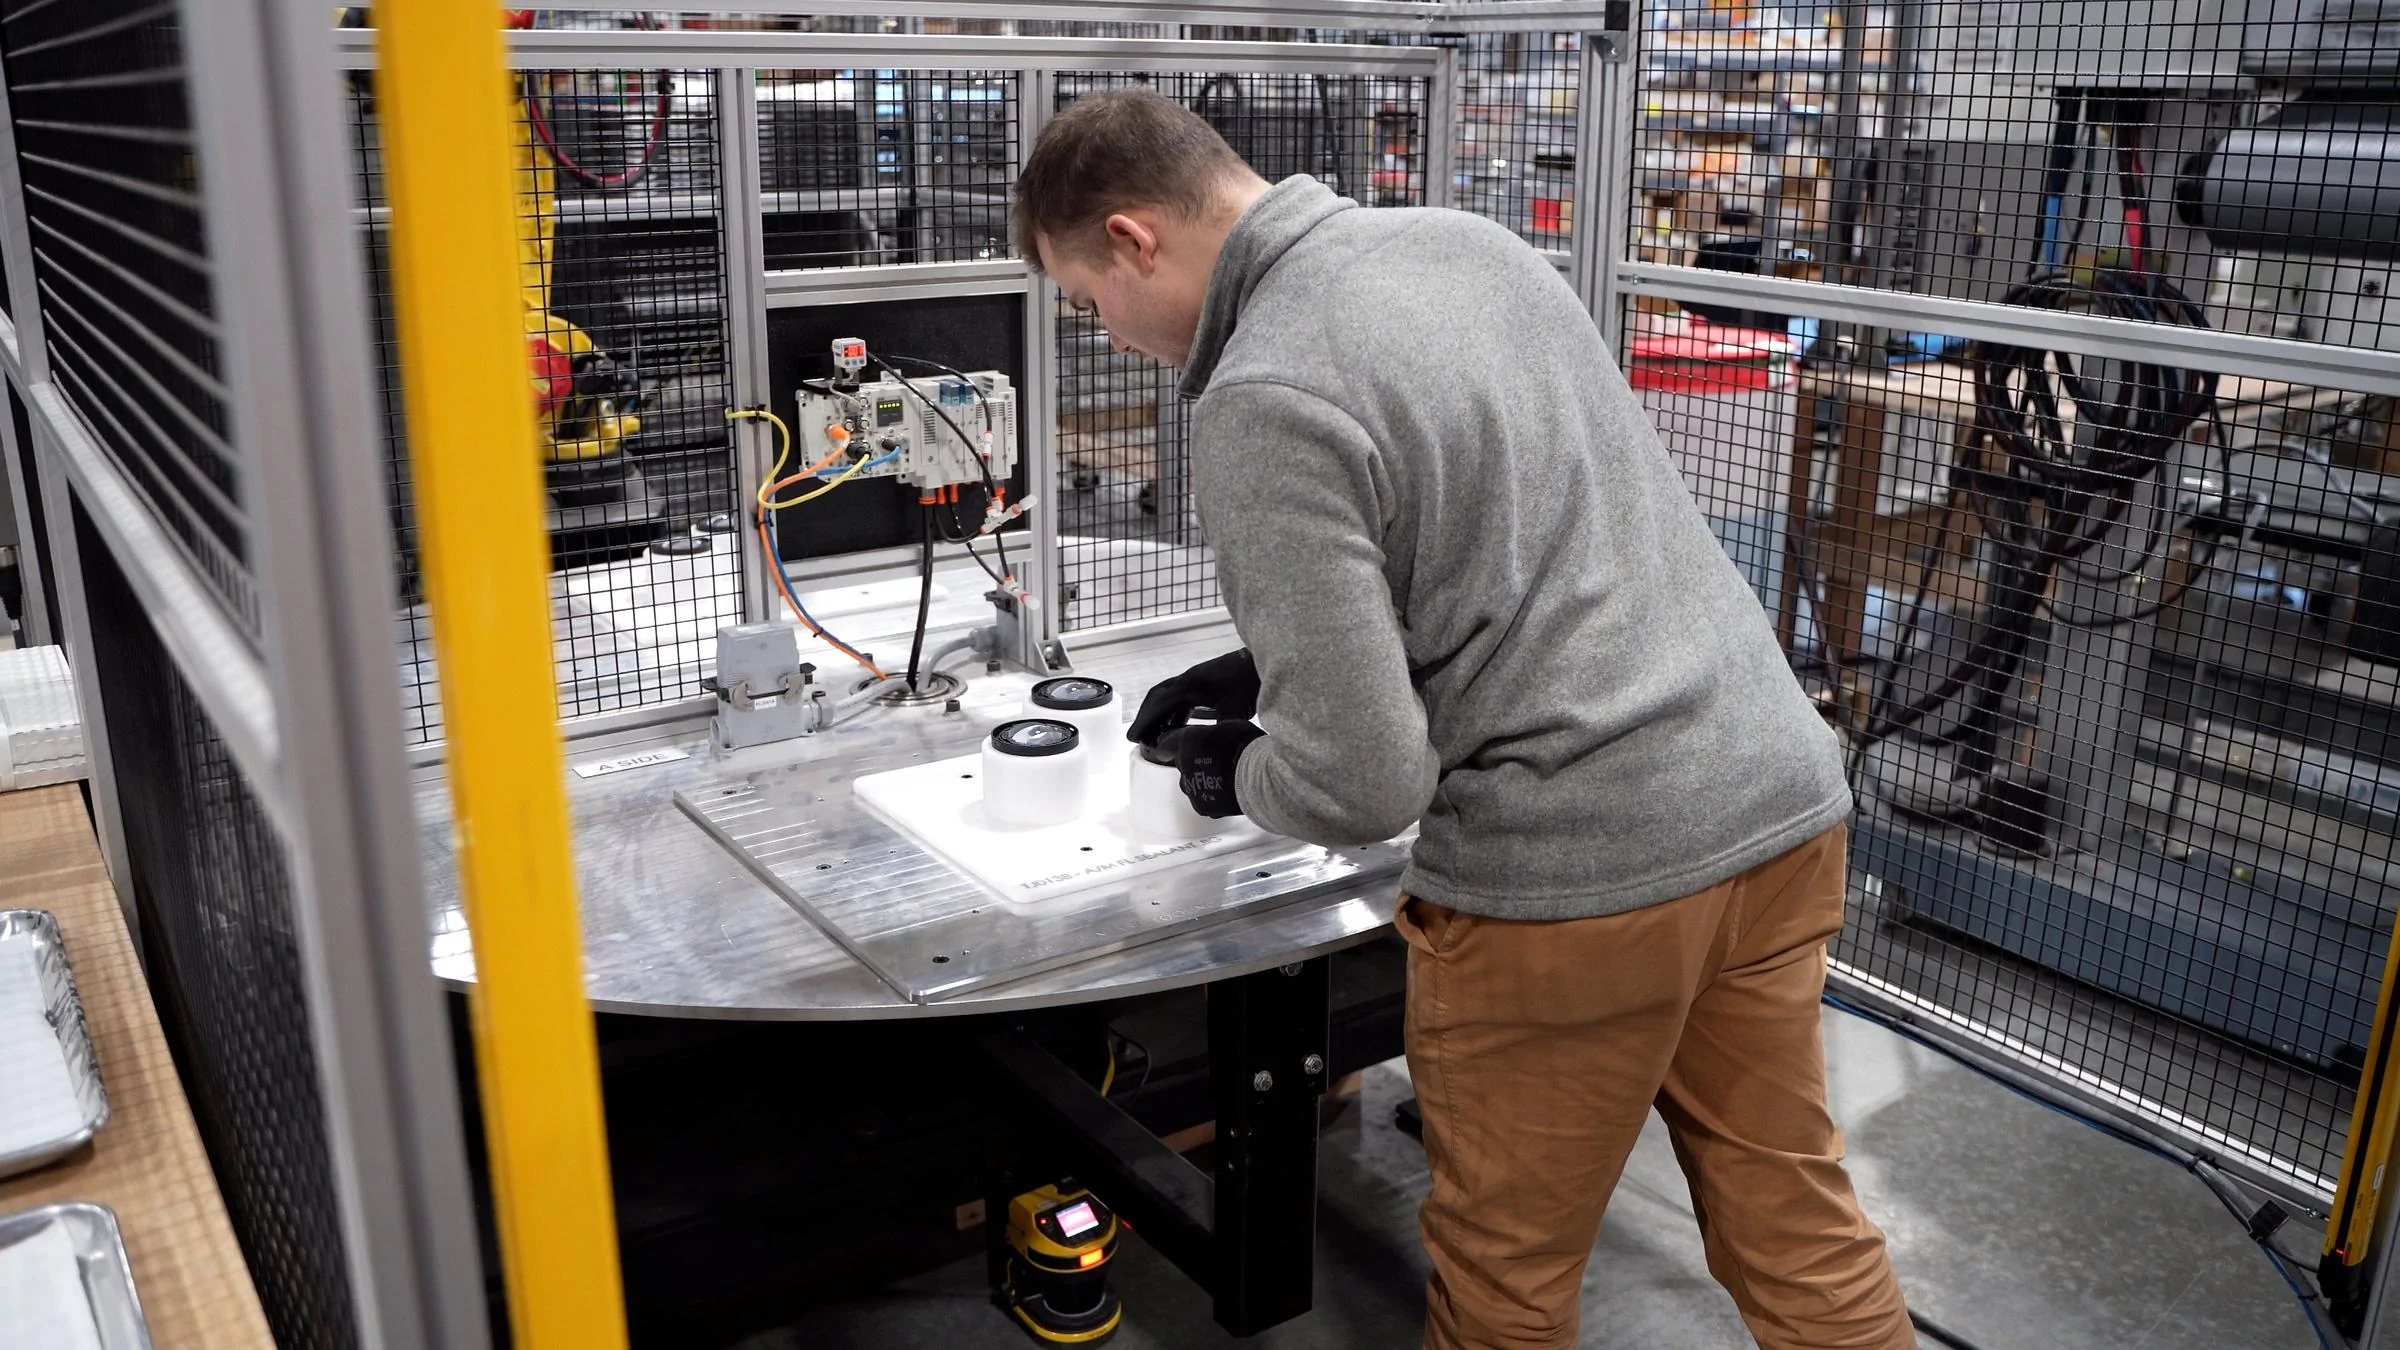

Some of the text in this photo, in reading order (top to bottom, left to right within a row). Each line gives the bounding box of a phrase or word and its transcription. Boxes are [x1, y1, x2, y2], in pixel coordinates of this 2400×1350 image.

[617, 753, 668, 767] SIDE
[1085, 862, 1117, 876] A/M
[1135, 841, 1197, 862] SEALANT
